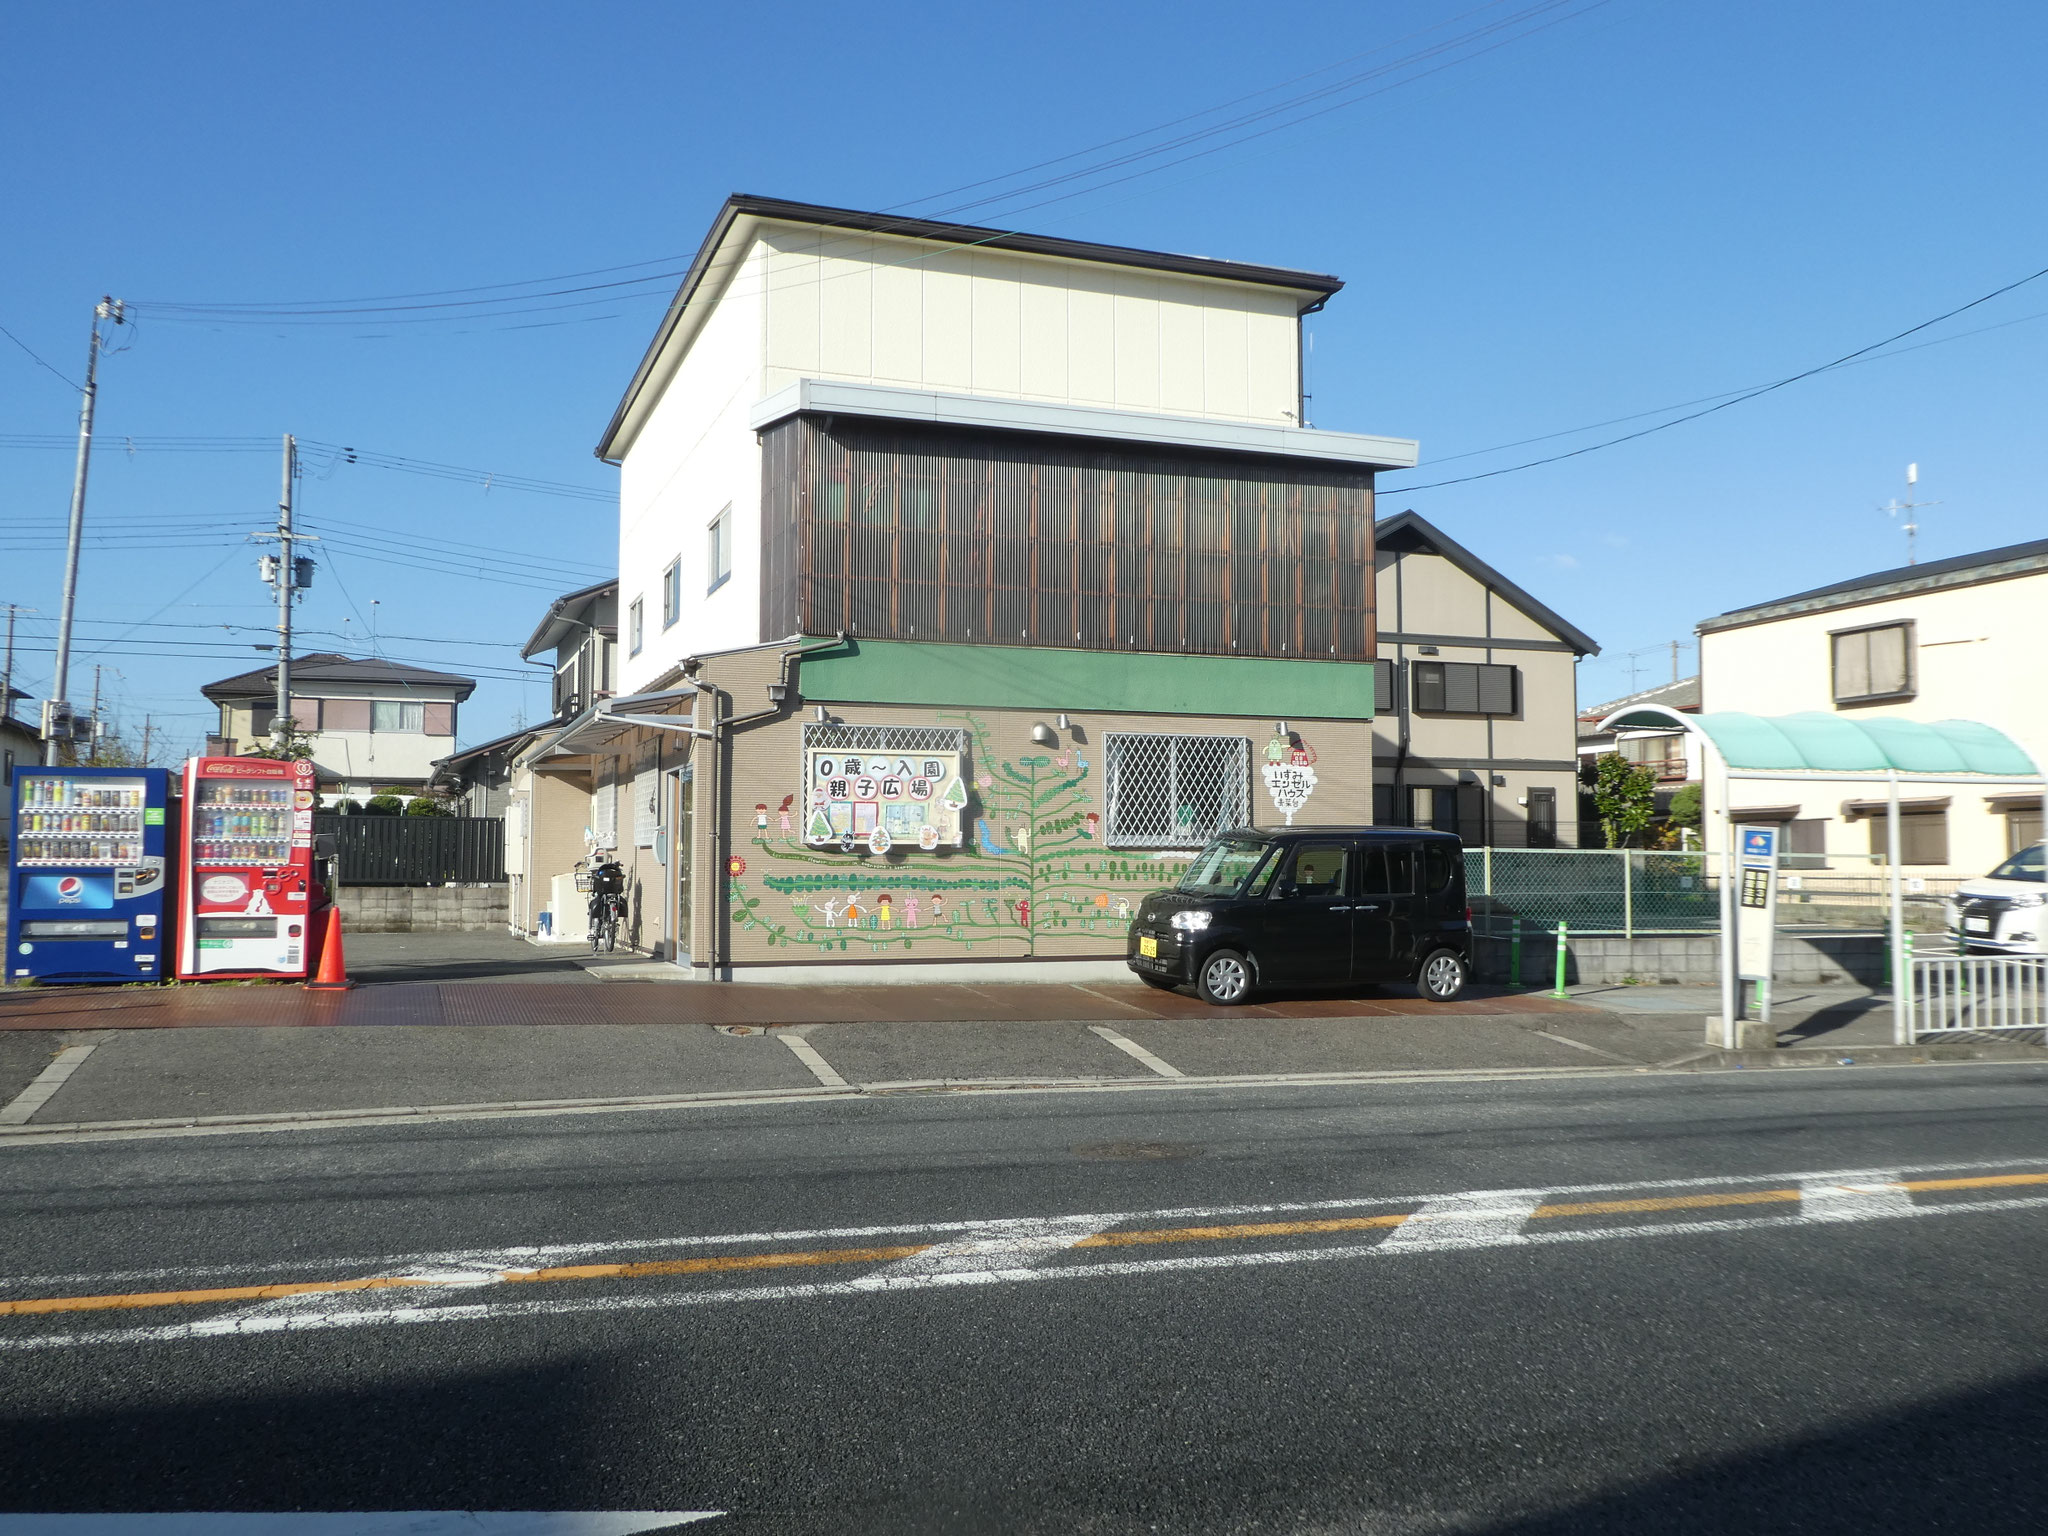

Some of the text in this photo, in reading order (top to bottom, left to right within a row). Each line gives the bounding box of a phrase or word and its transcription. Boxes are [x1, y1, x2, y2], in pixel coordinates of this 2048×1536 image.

[1274, 769, 1303, 780] いずみ
[829, 778, 928, 798] 親子広場
[1271, 780, 1310, 788] エンゼル
[1278, 789, 1305, 798] ハウス
[808, 856, 828, 864] flower
[58, 897, 81, 905] pepsi
